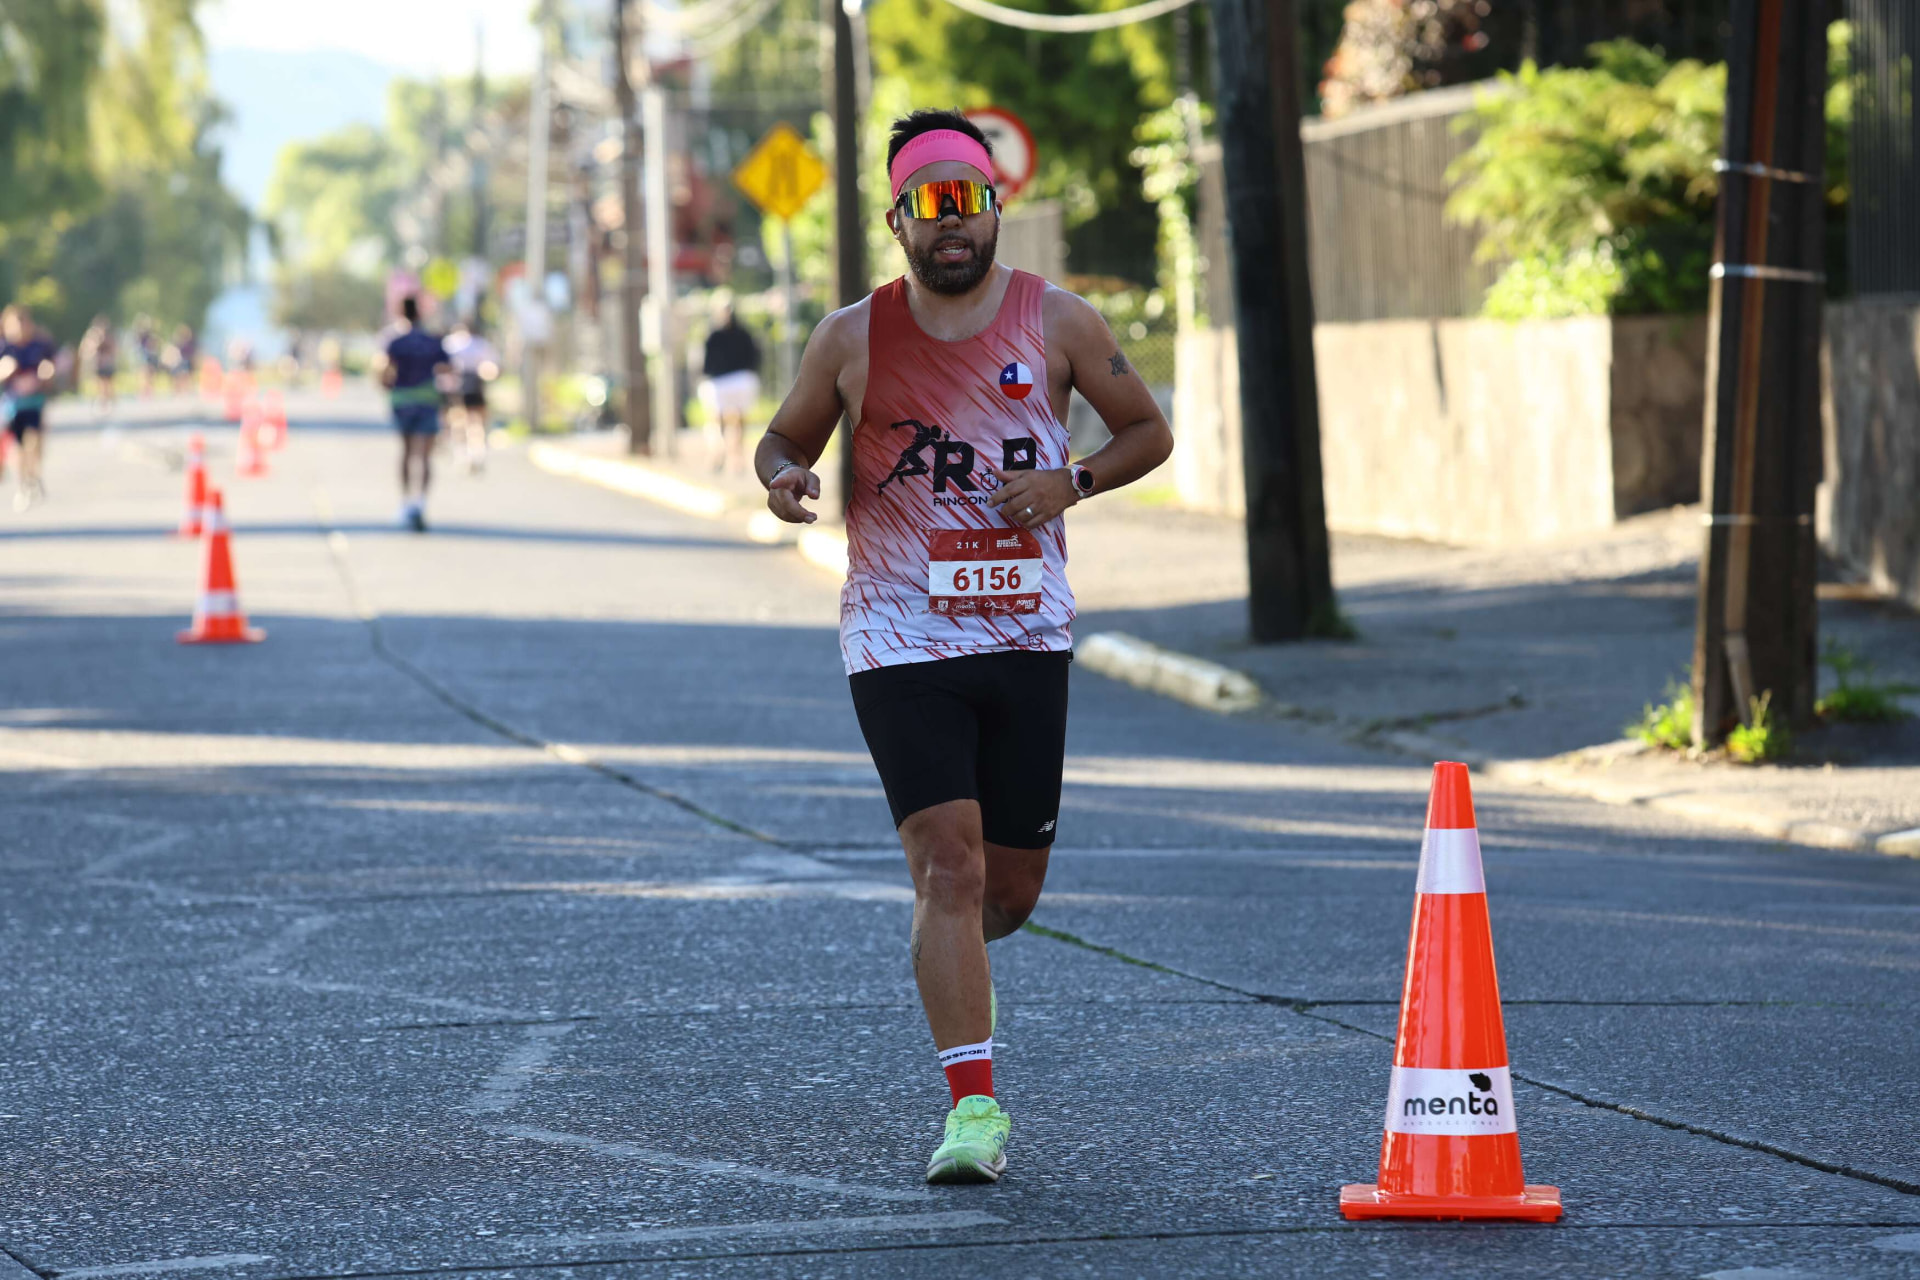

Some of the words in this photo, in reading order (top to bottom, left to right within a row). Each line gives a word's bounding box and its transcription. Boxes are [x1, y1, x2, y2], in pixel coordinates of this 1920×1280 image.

[909, 131, 959, 152] FINISHER
[933, 496, 988, 506] RINCON
[953, 565, 1021, 591] 6156
[1404, 1091, 1498, 1116] menta
